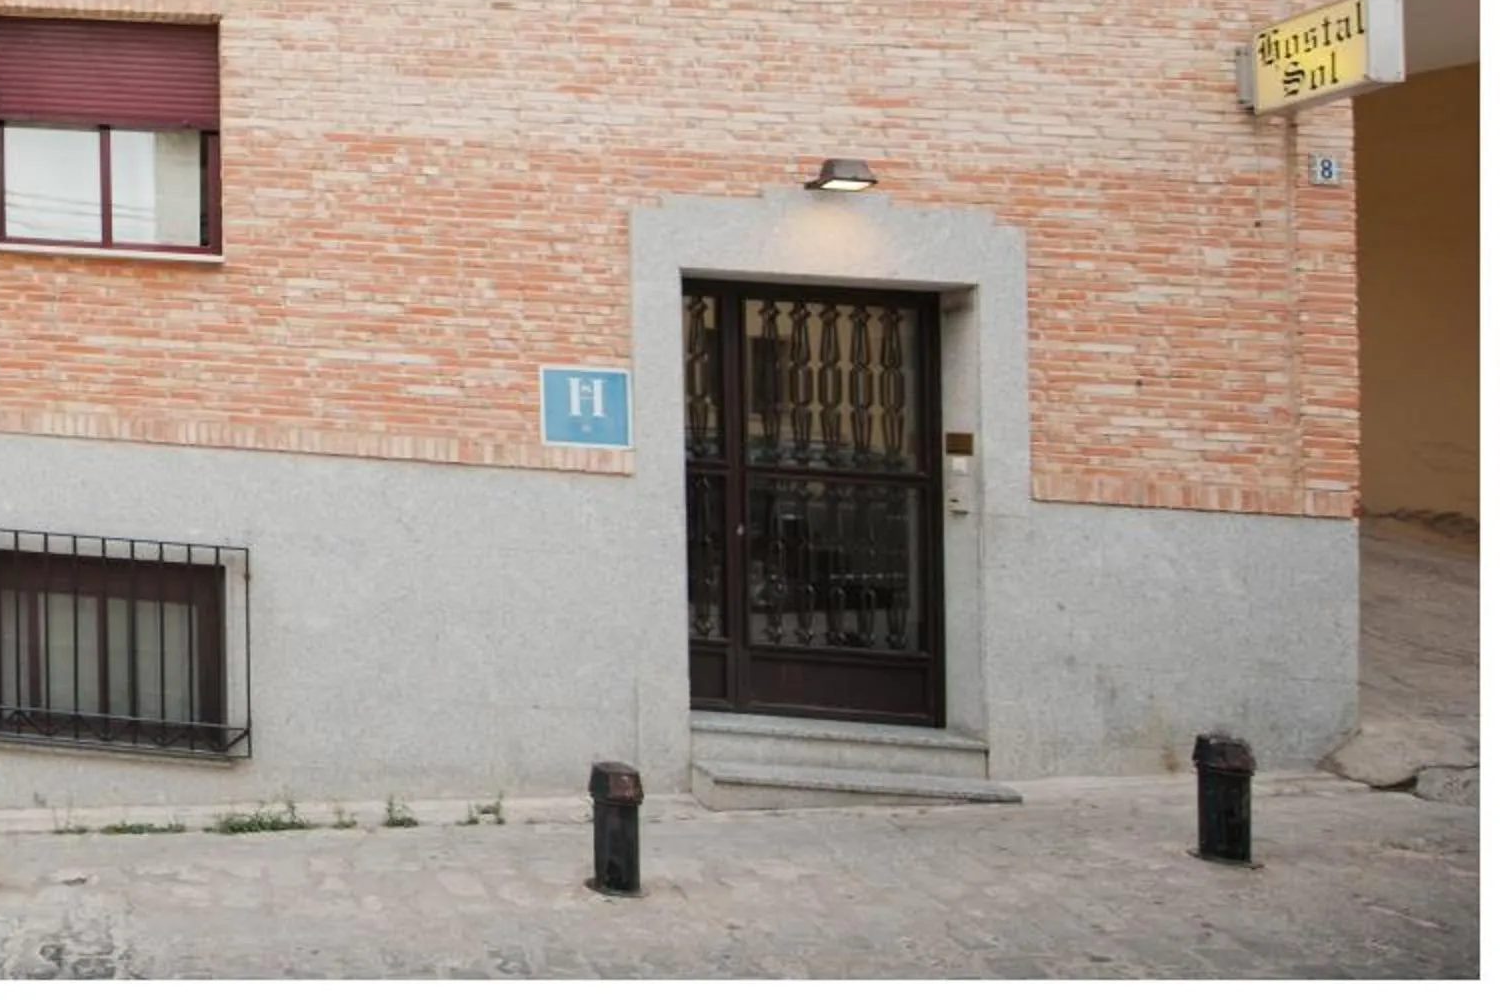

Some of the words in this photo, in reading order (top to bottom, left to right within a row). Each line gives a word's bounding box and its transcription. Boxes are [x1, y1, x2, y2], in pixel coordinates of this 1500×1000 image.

[1257, 0, 1366, 67] Hostal
[1283, 50, 1340, 98] Sol
[1320, 158, 1334, 180] 8
